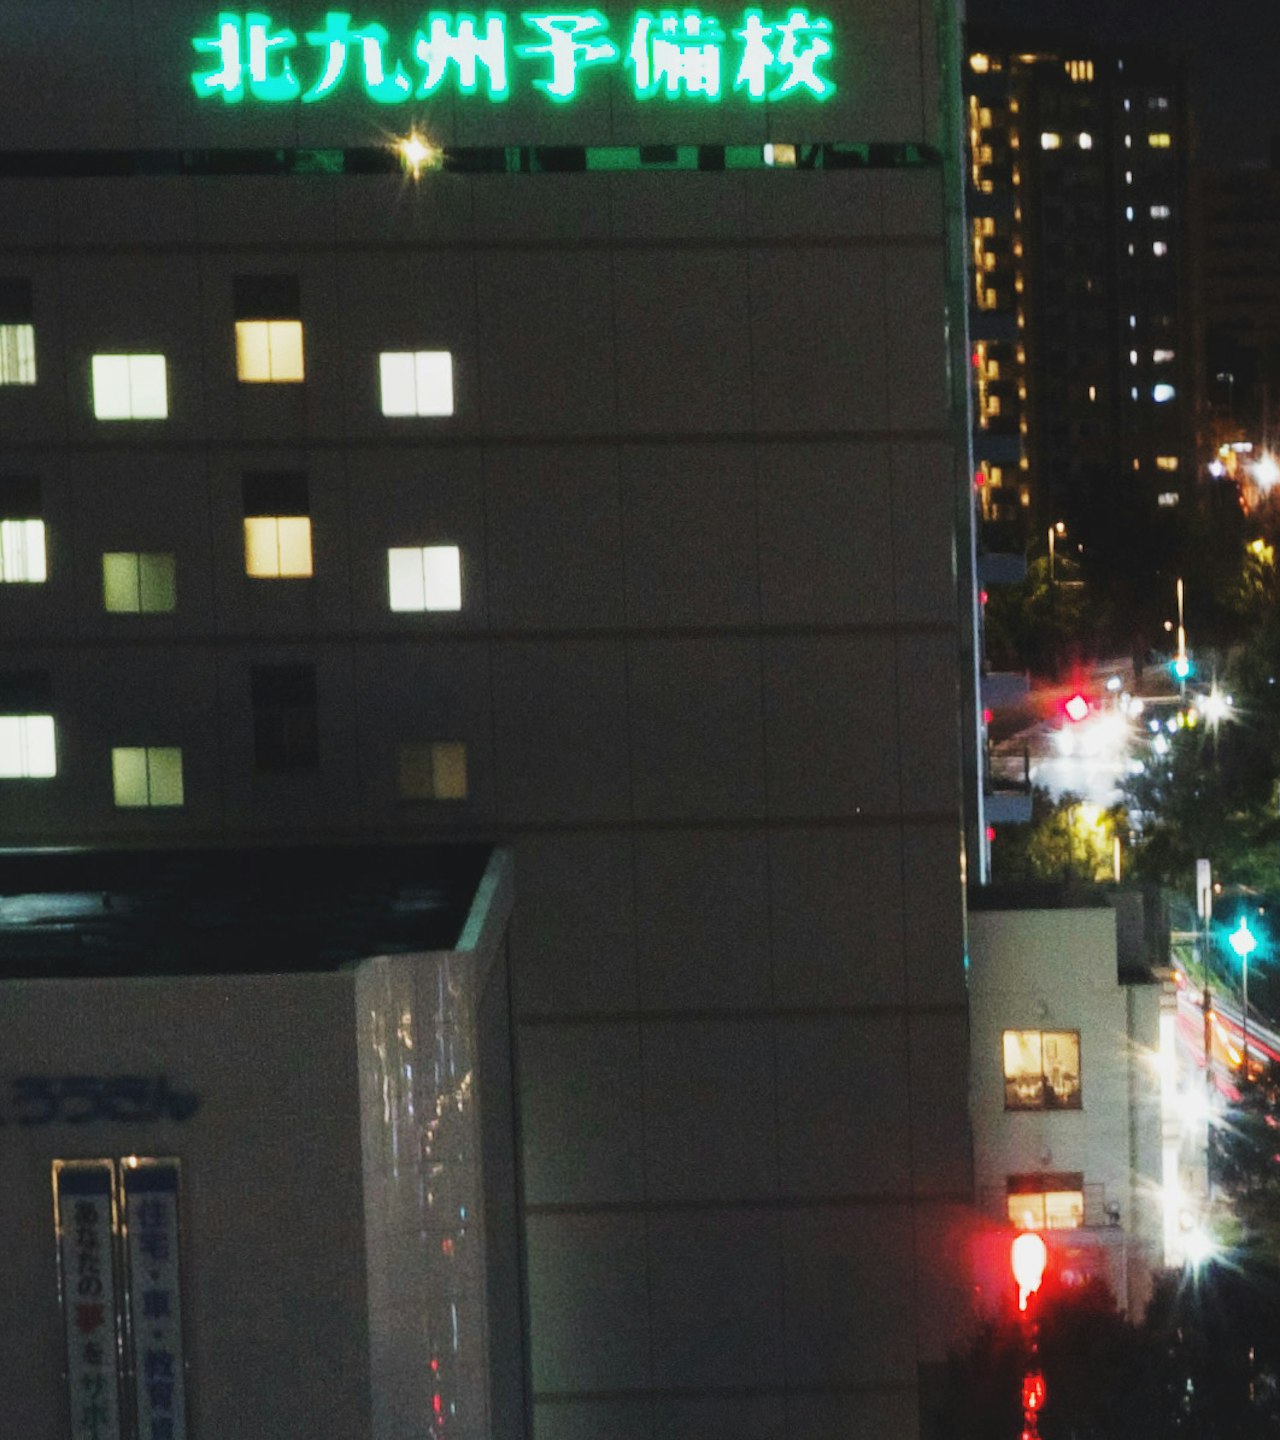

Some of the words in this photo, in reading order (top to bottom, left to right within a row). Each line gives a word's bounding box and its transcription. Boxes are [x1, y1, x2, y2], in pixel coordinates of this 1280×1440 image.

[191, 8, 836, 104] 北九州予備校
